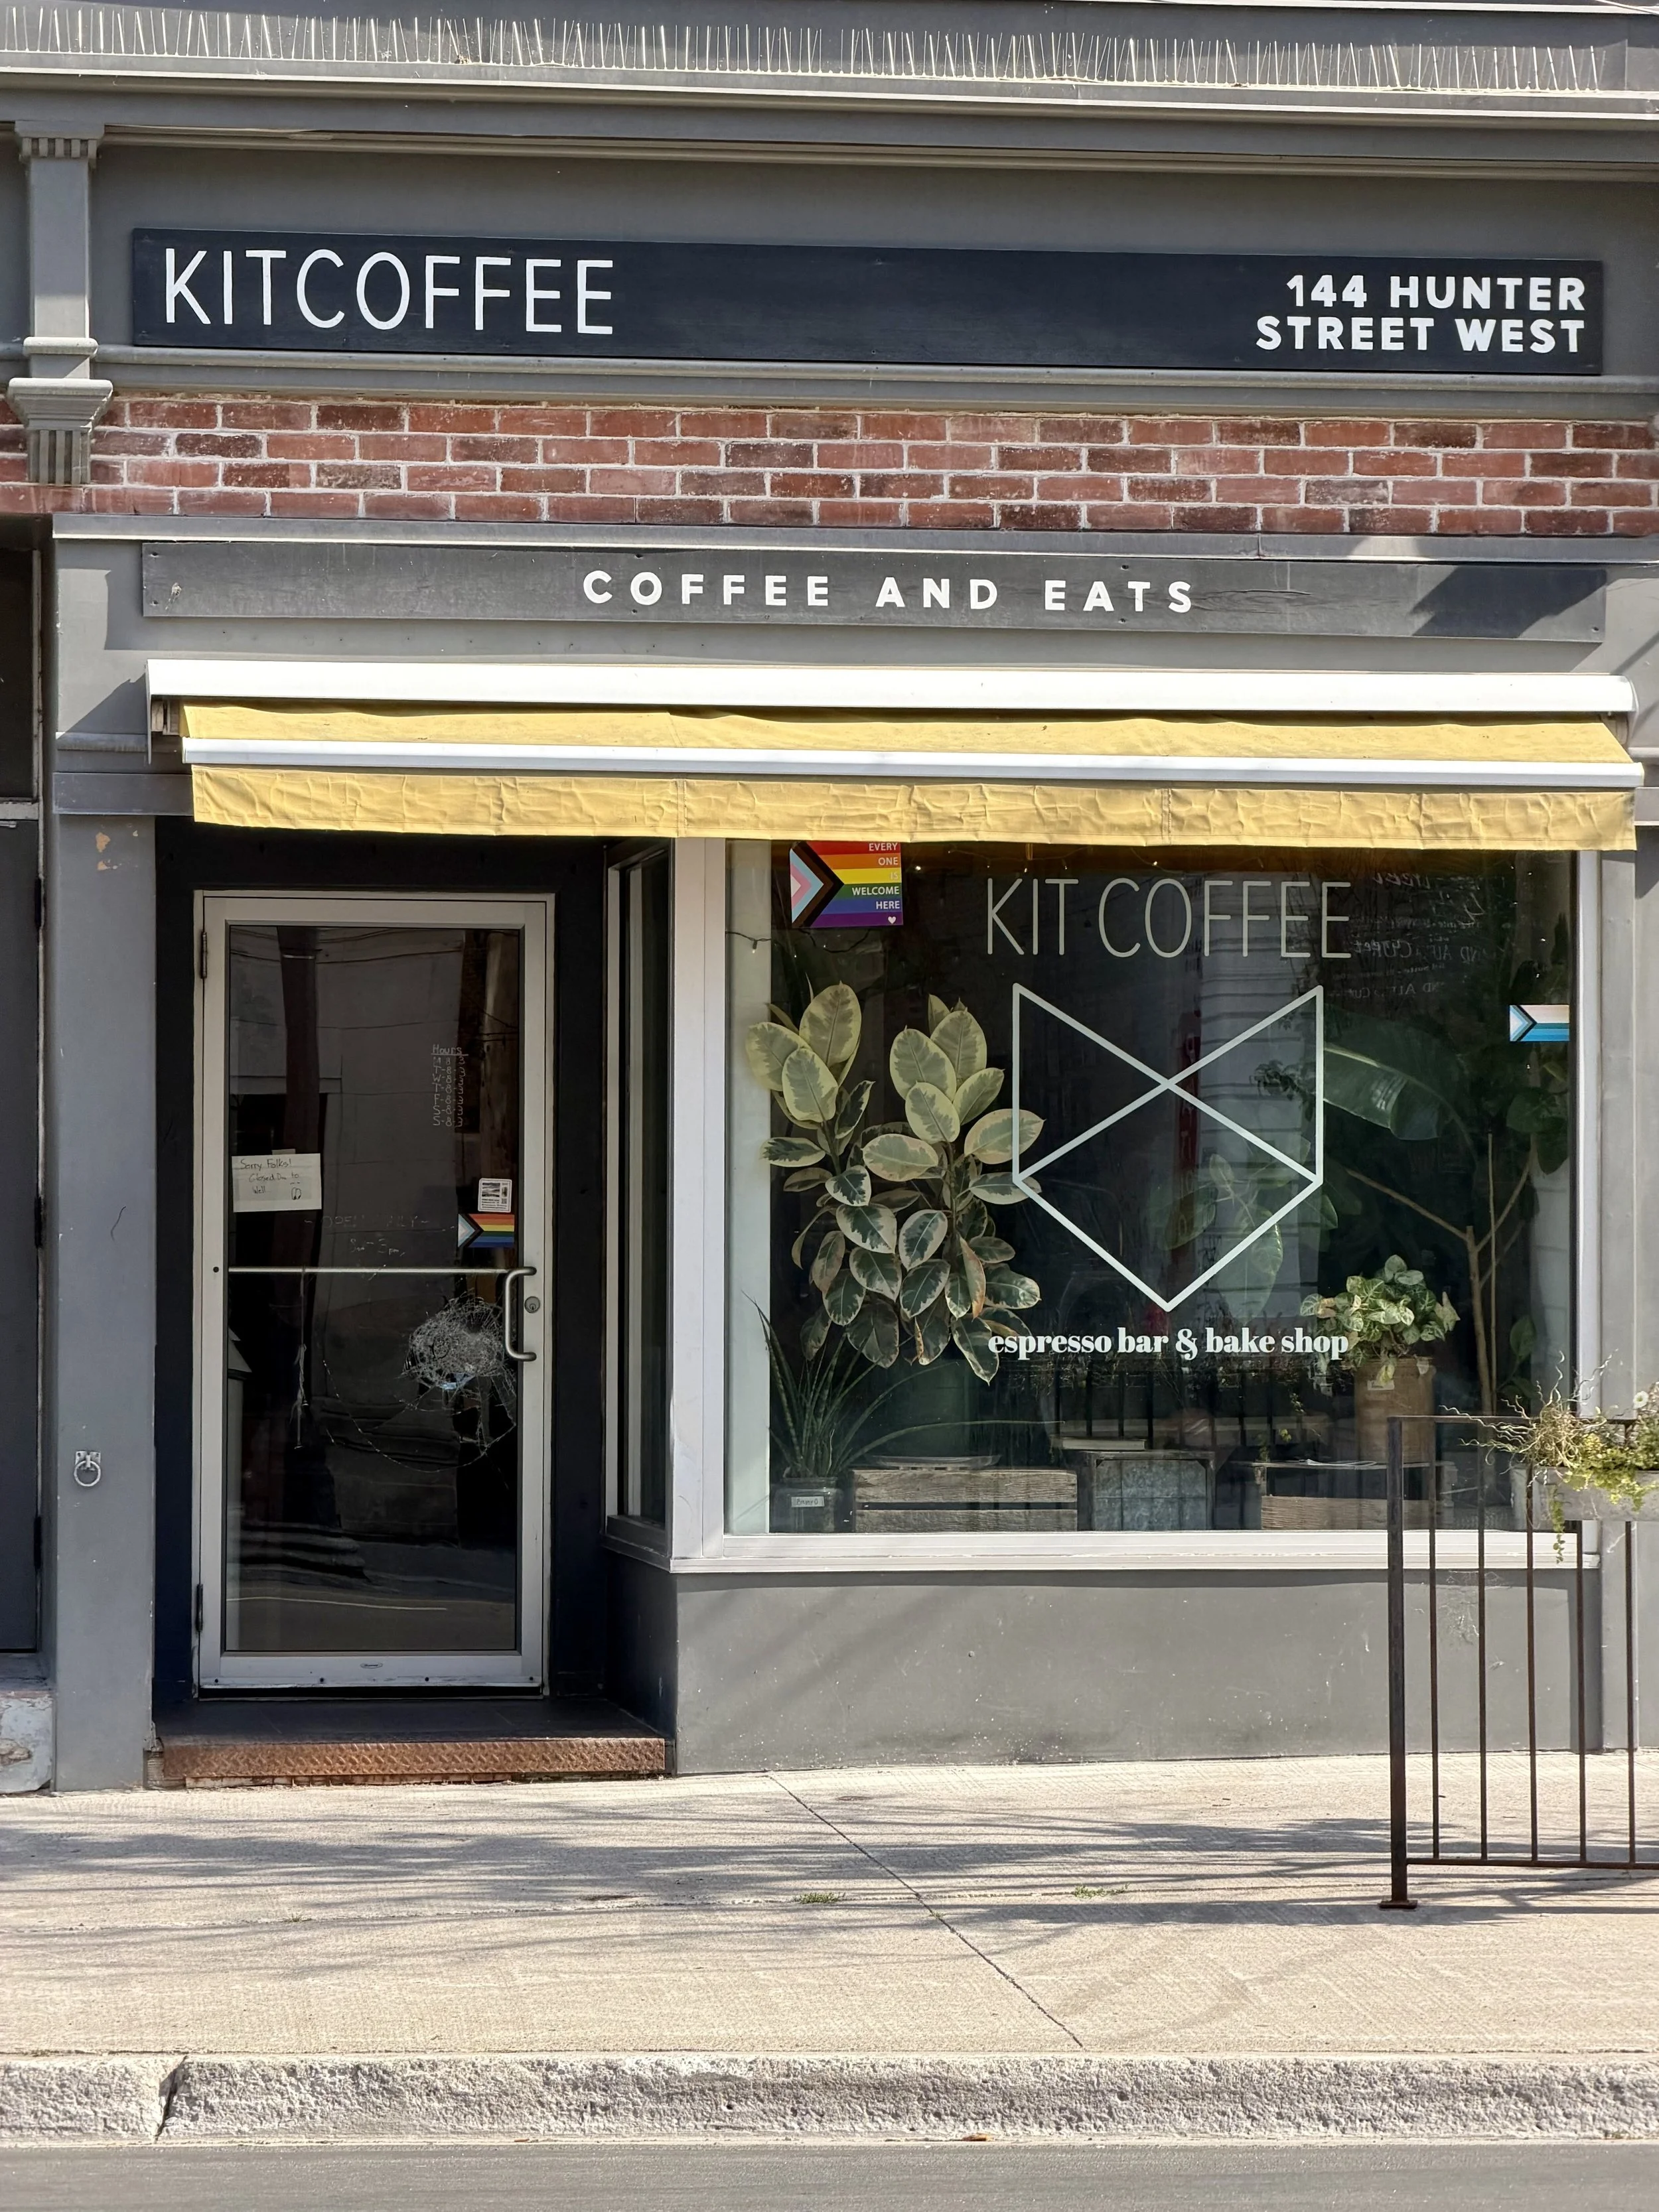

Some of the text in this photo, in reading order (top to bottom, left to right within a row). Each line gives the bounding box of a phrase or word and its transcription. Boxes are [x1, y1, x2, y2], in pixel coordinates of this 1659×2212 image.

[1287, 275, 1585, 311] 144 HUNTER
[1256, 316, 1584, 353] STREET WEST
[583, 571, 1191, 612] COFFEE AND EATS
[869, 843, 898, 851] EVERY
[878, 857, 899, 866] ONE
[852, 886, 900, 896] WELCOME
[876, 901, 901, 910] HERE
[988, 879, 1078, 955] KIT
[1100, 879, 1350, 957] COFFEE
[433, 1044, 463, 1054] Hours
[240, 1158, 262, 1171] Sorry
[987, 1326, 1349, 1360] espresso bar & bake shop
